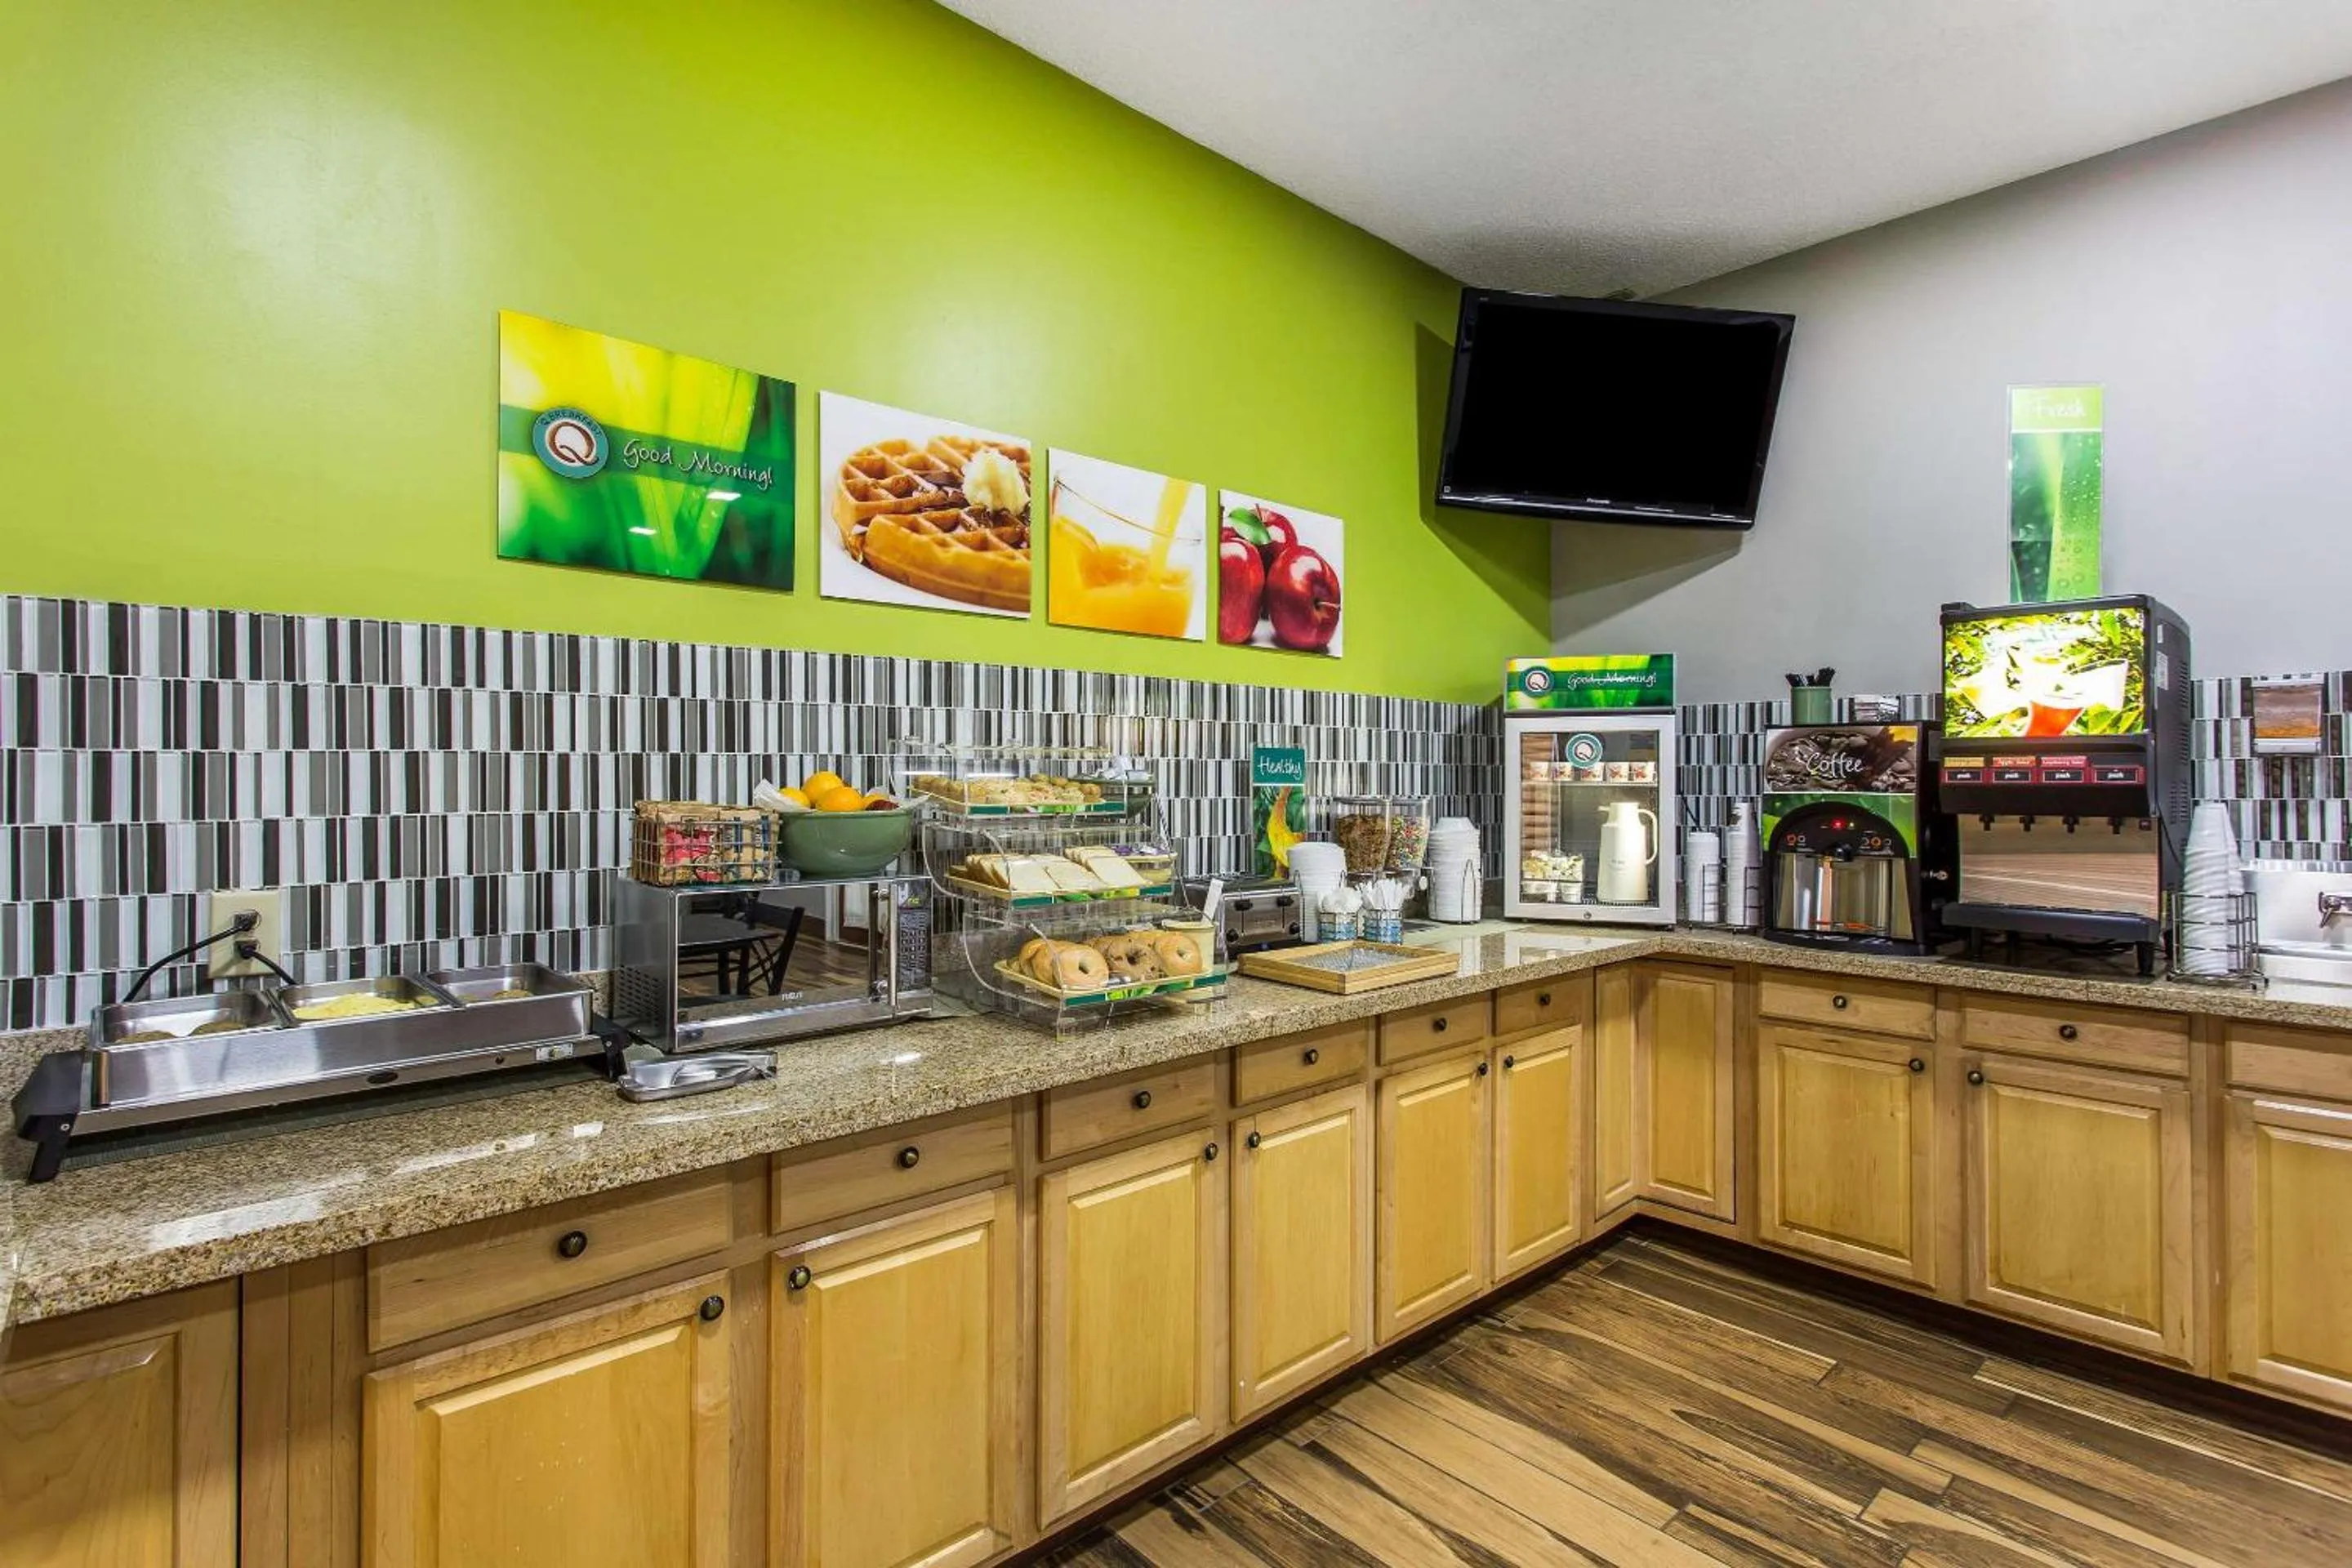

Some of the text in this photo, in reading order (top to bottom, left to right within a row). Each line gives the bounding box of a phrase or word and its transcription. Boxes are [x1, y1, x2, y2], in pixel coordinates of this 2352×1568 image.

[548, 421, 599, 466] Q
[623, 438, 773, 492] Good Morning!
[1567, 671, 1656, 690] Good Morning!
[1257, 755, 1303, 781] Healthy
[1806, 751, 1864, 779] Coffee
